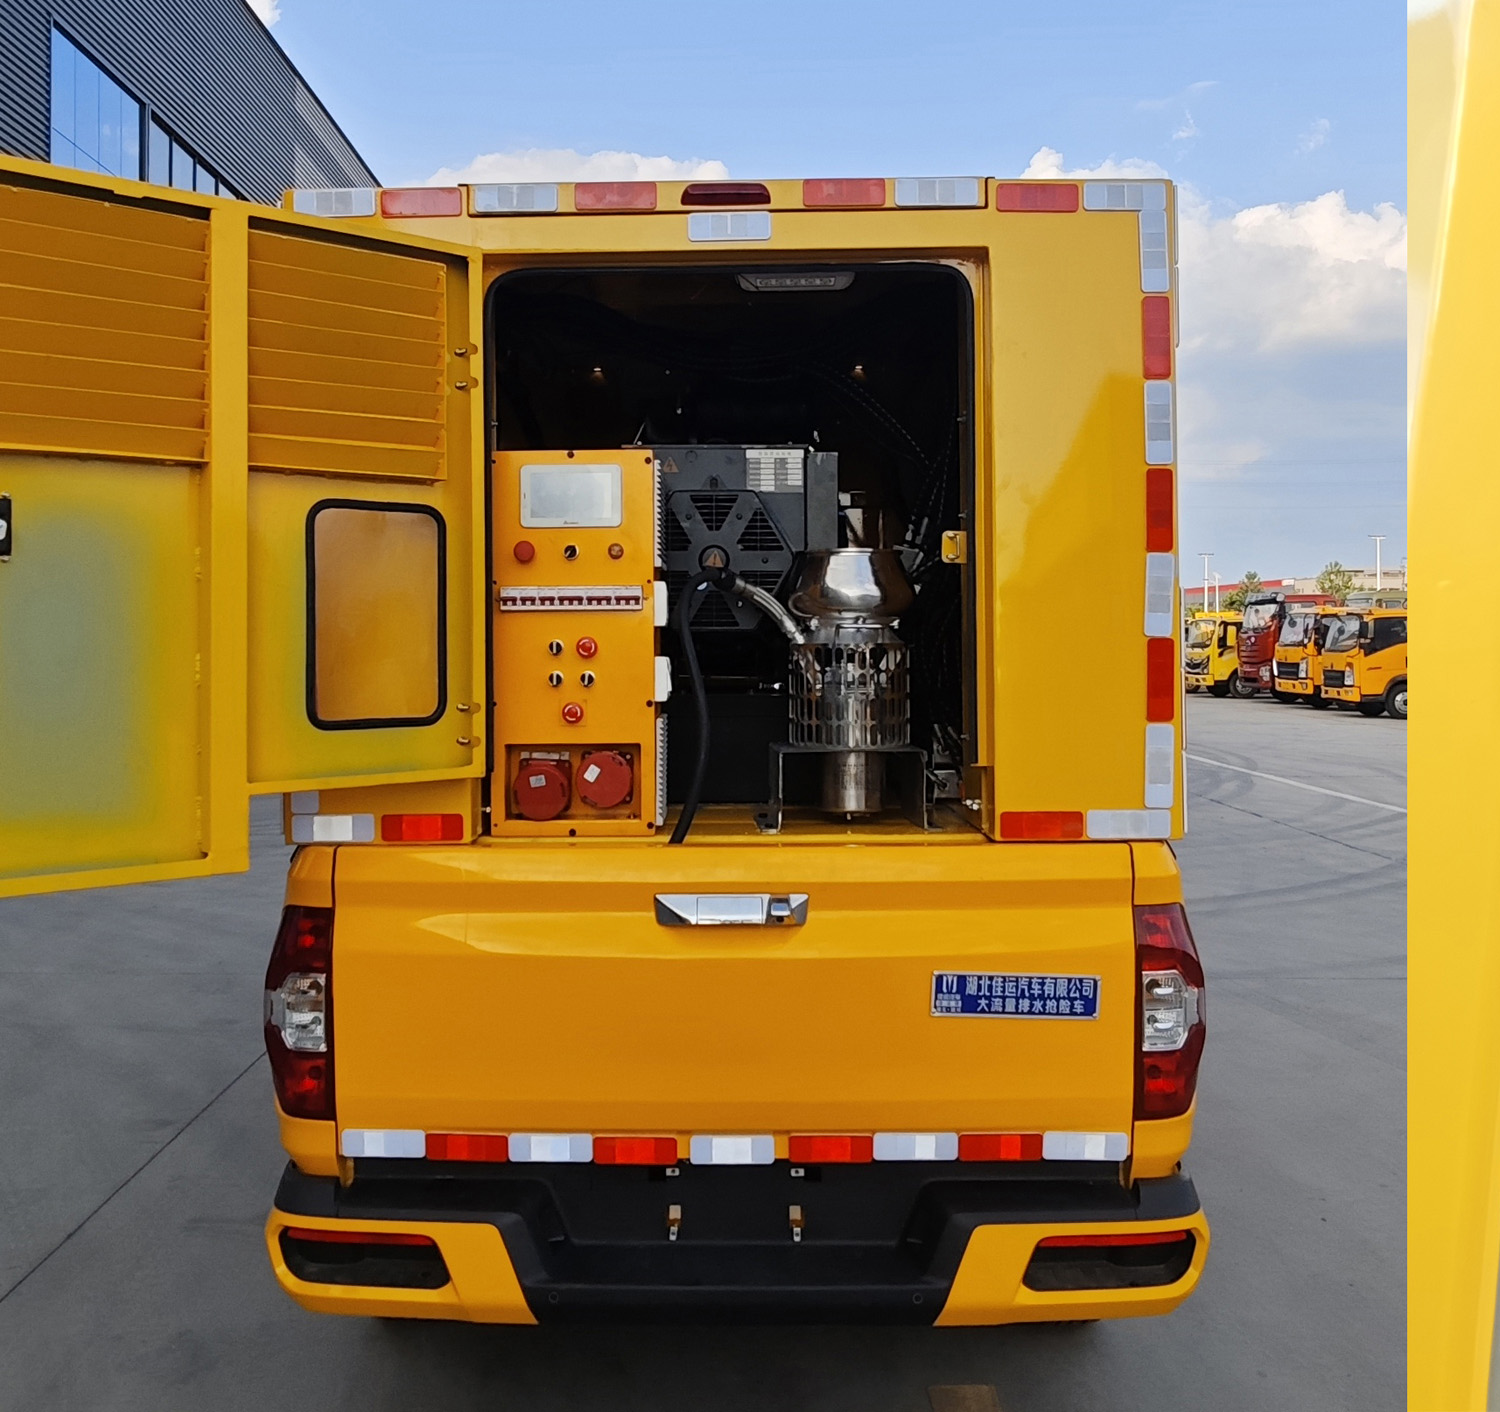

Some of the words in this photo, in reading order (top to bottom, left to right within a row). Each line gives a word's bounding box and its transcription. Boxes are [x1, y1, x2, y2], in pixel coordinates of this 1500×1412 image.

[965, 975, 1094, 998] 湖北佳运汽车有限公司
[977, 998, 1085, 1014] 大流量排水抢险车
